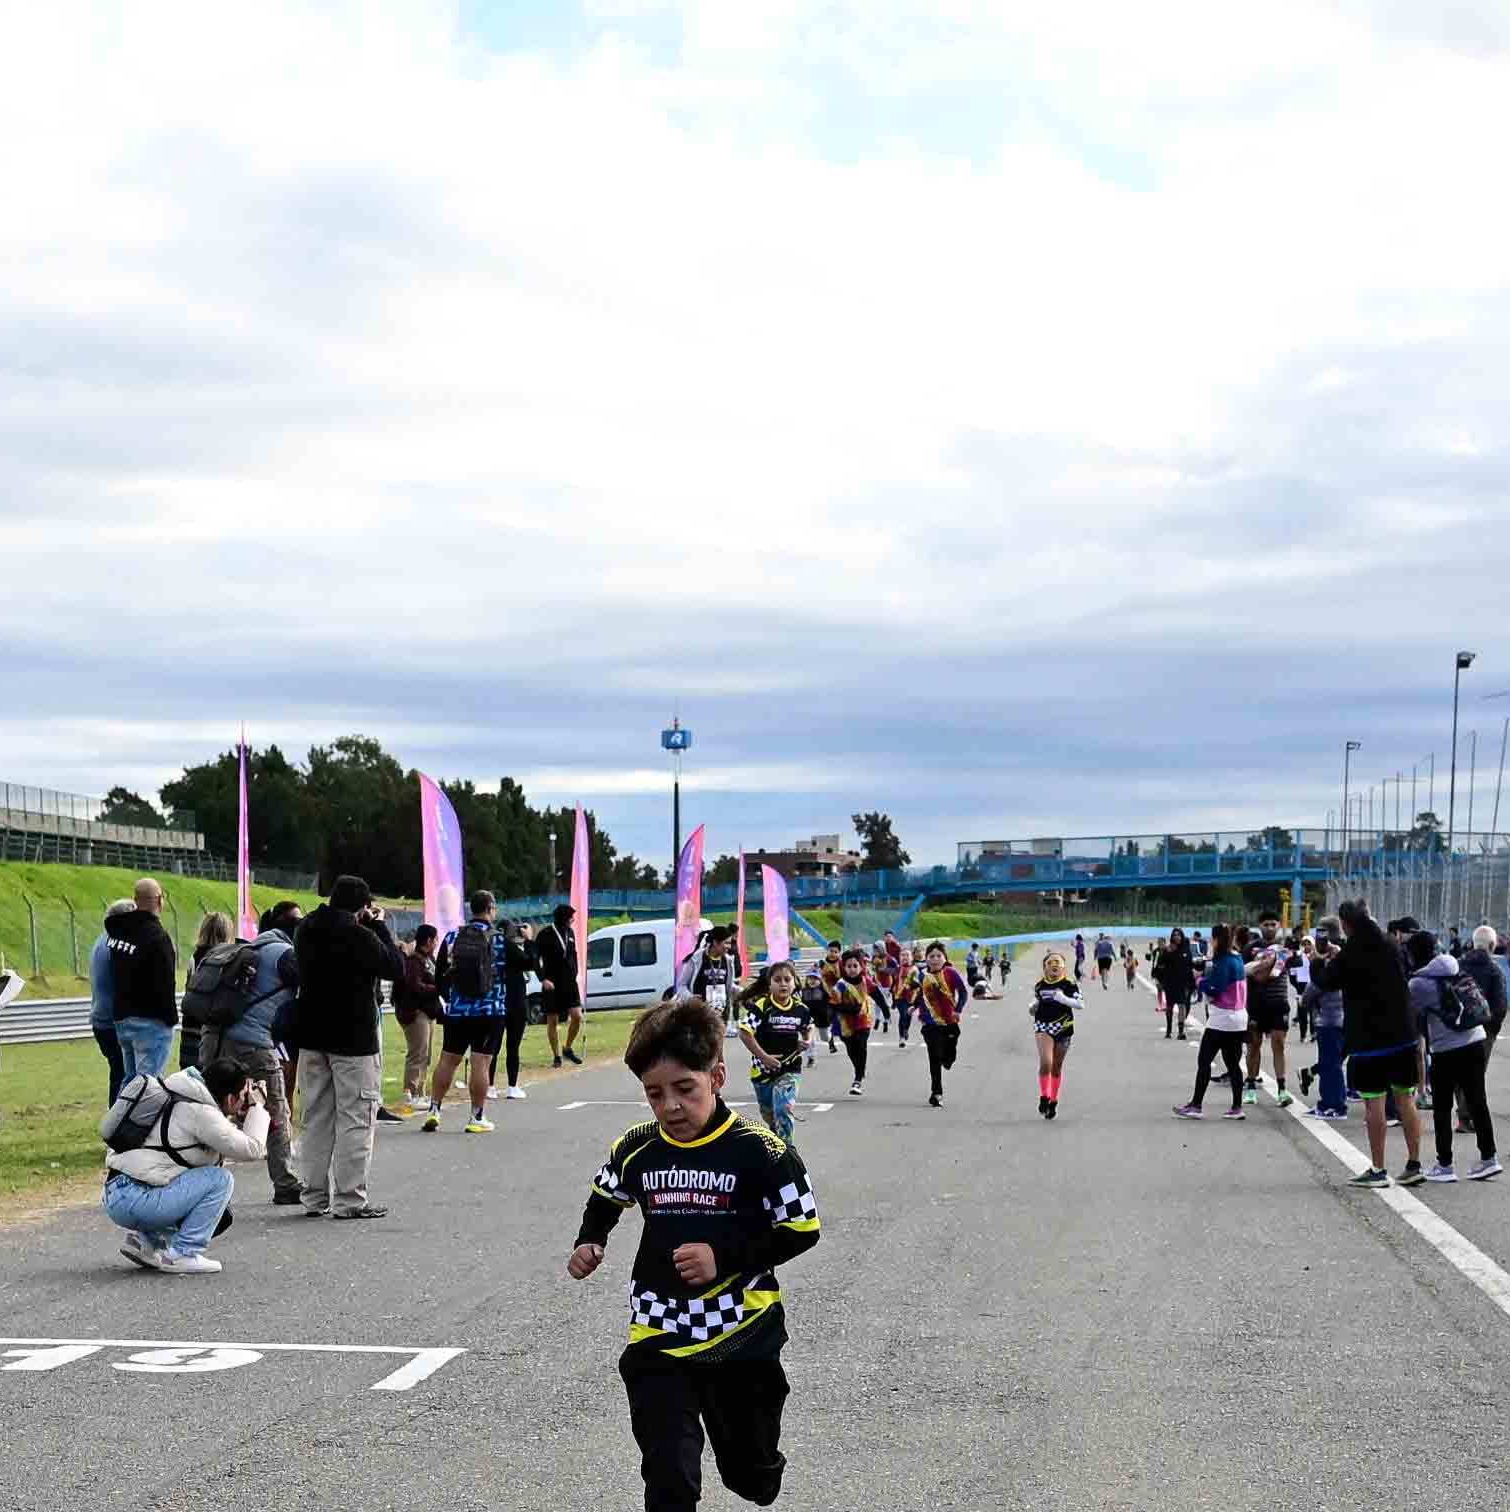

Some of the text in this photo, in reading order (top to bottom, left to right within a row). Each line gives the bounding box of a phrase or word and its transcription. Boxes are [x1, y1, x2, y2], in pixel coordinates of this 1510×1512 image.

[642, 1164, 737, 1193] AUTÓDROMO
[654, 1192, 717, 1206] RUNNING RACE
